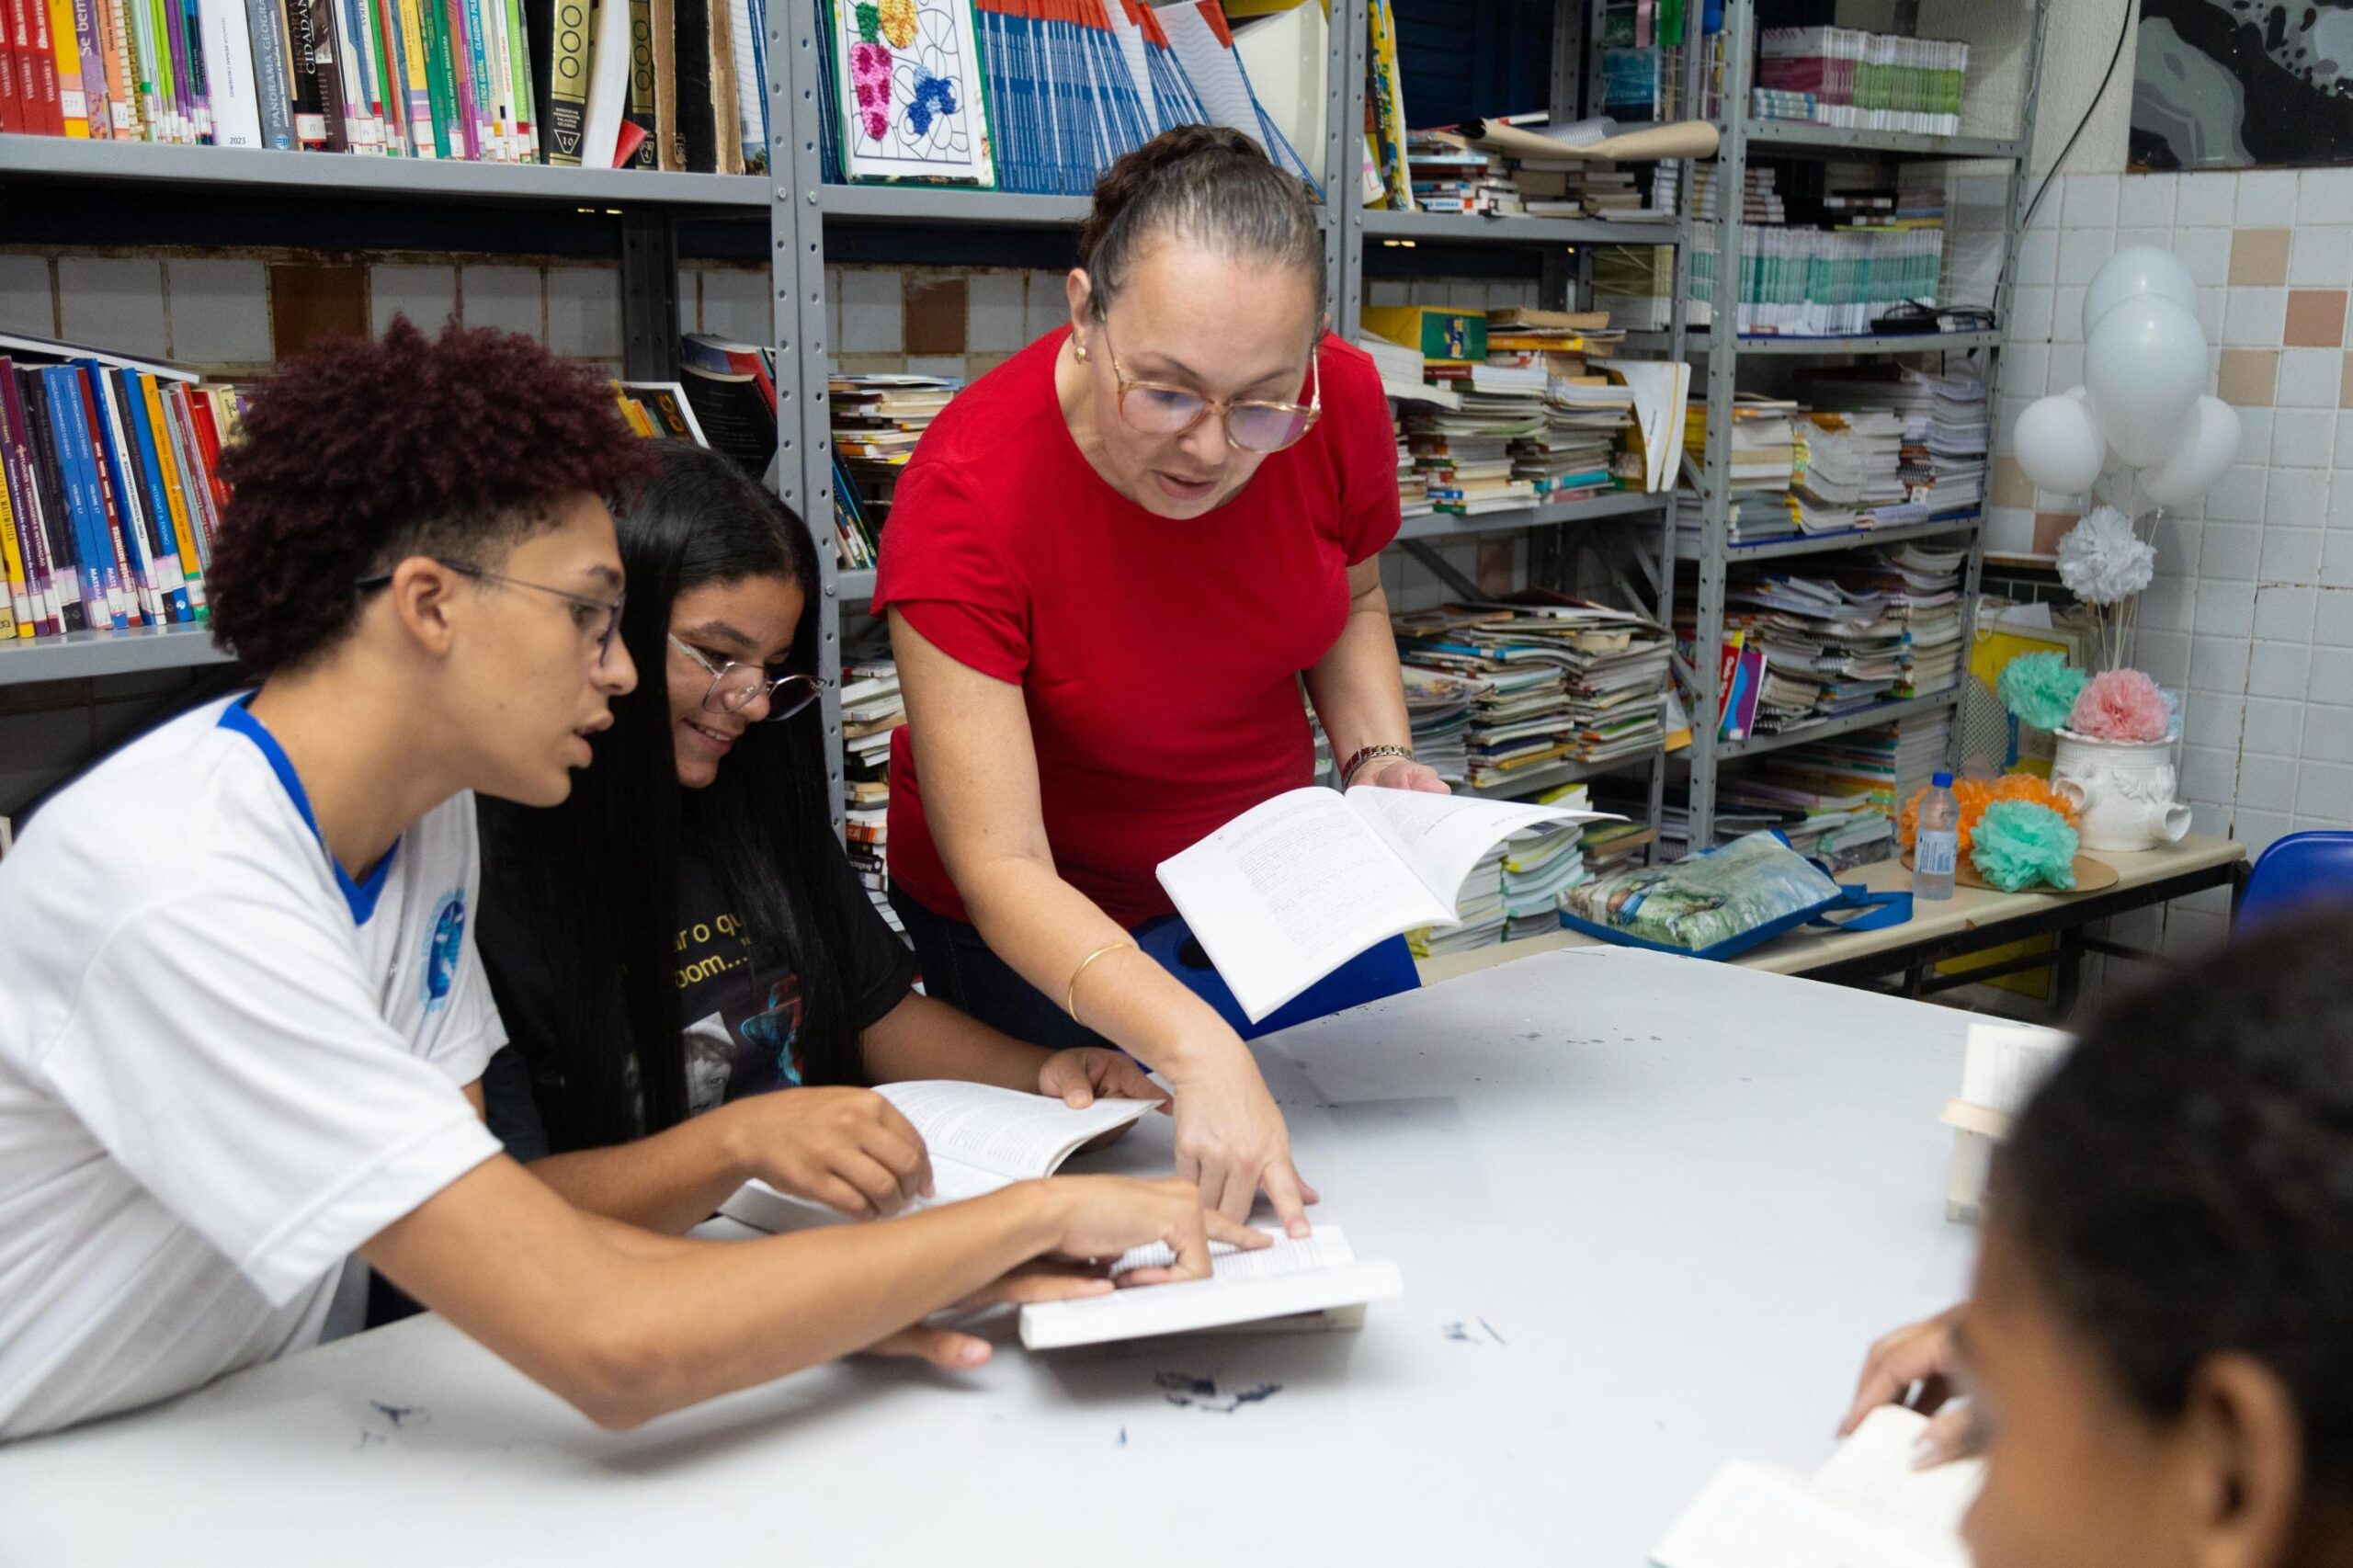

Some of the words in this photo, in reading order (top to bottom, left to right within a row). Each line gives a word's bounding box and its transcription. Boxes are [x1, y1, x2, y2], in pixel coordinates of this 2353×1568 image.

[80, 38, 92, 56] Se
[298, 0, 315, 74] CIDADAN
[472, 14, 482, 51] CLAUDINO
[442, 35, 450, 68] BRASILEIRA
[23, 62, 34, 99] VOLUME
[44, 65, 55, 102] VOLUME
[265, 55, 279, 127] PANORAMA
[230, 137, 246, 145] 2023
[563, 137, 574, 146] 10
[50, 375, 59, 398] COLEÇÃO
[63, 438, 72, 459] ENSINO
[67, 375, 76, 398] COLEÇÃO
[81, 439, 89, 459] ENSINO
[1, 501, 15, 540] MATEMÁTICA
[26, 488, 38, 523] LINGUAGEM
[34, 530, 45, 566] INTERAÇÃO
[152, 483, 163, 513] INTERNET
[160, 521, 170, 545] ENSINO
[112, 526, 126, 562] MATEMÁTICA
[119, 562, 133, 593] EDUCAÇÃO
